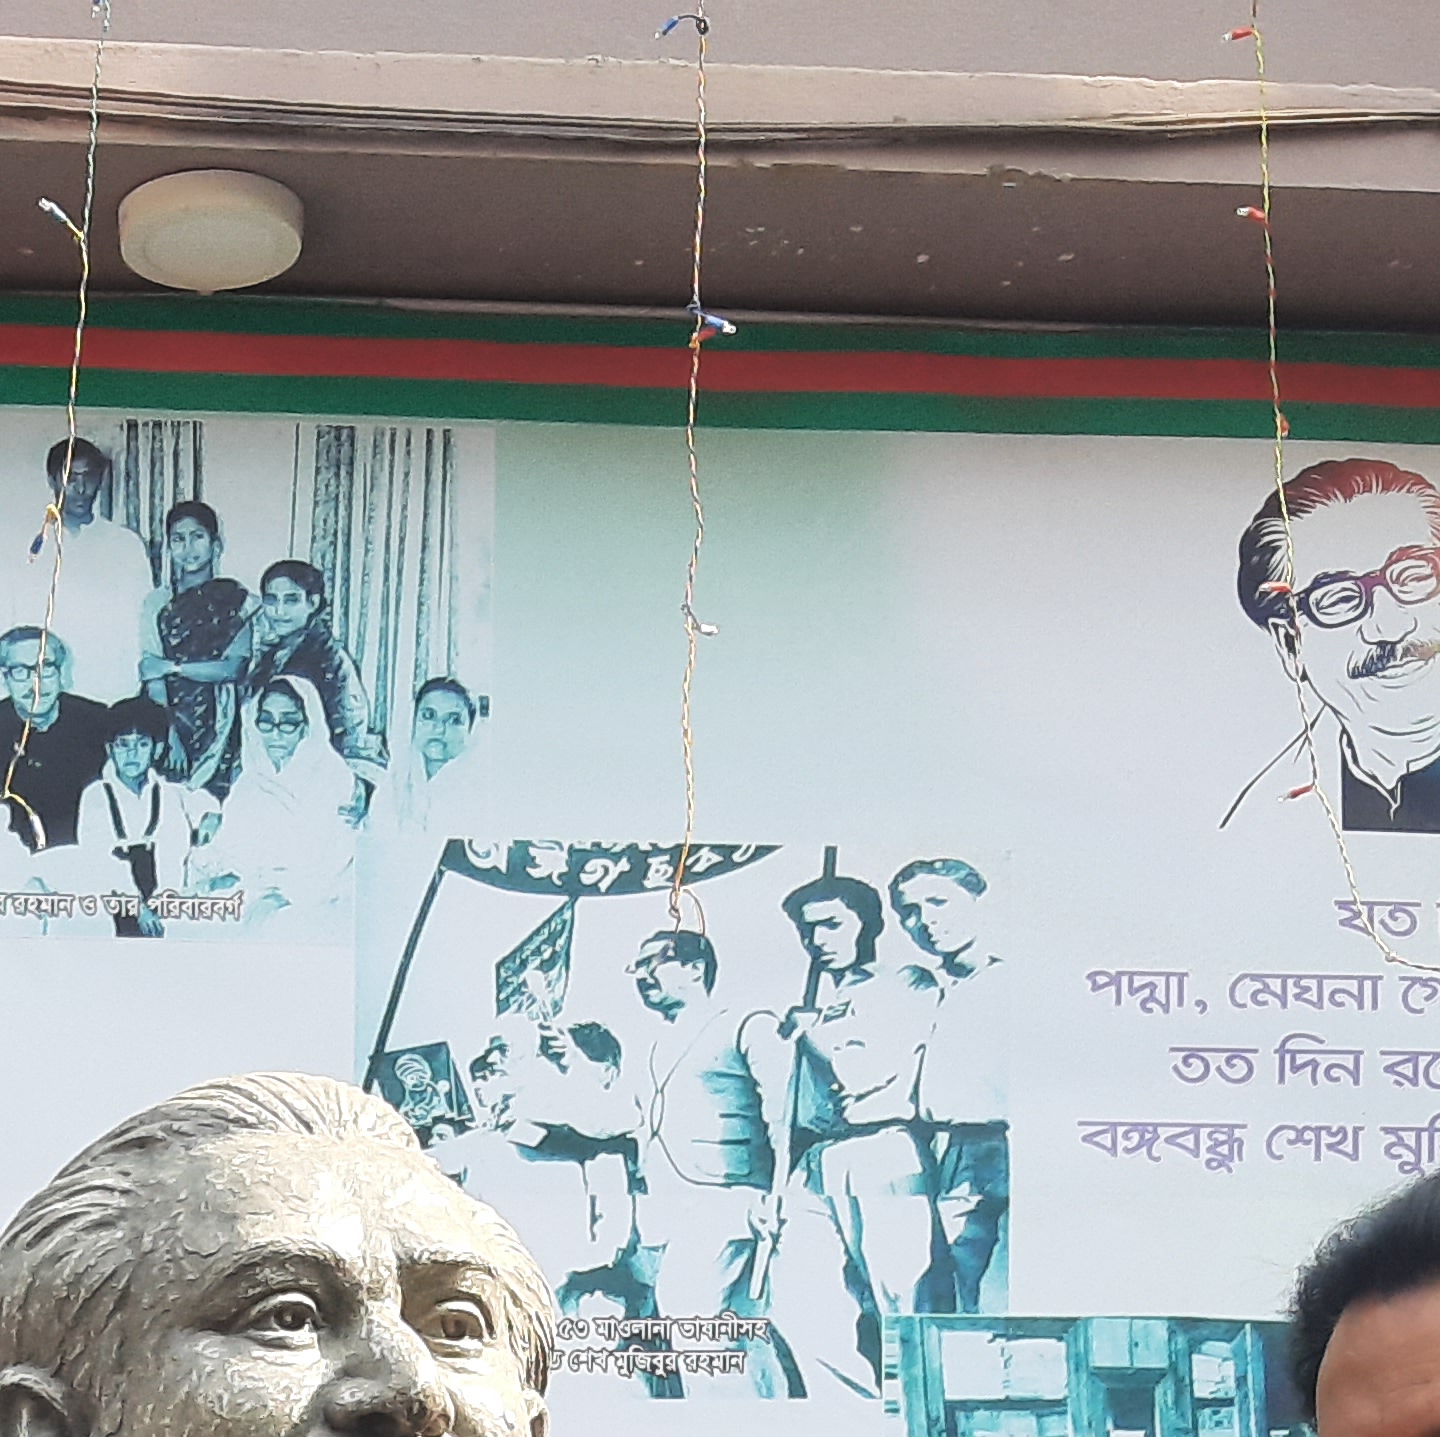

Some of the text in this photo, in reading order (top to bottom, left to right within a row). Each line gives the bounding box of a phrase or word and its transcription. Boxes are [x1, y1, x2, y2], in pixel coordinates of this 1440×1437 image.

[10, 891, 75, 920] রহমান
[79, 894, 97, 917] ও
[145, 888, 244, 920] পরিবারবর্গ
[1335, 897, 1420, 939] যত
[1085, 969, 1209, 1016] পদ্মা,
[1228, 972, 1384, 1012] মেঘনা
[1168, 1044, 1257, 1087] তত
[1274, 1034, 1362, 1089] দিন
[1079, 1118, 1248, 1175] বঙ্গবন্ধু
[1265, 1122, 1363, 1165] শেখ
[593, 1315, 672, 1342] মাওলানা
[568, 1347, 609, 1374] শেখ
[611, 1343, 680, 1379] মুজিবুর
[682, 1349, 745, 1377] রহমান
